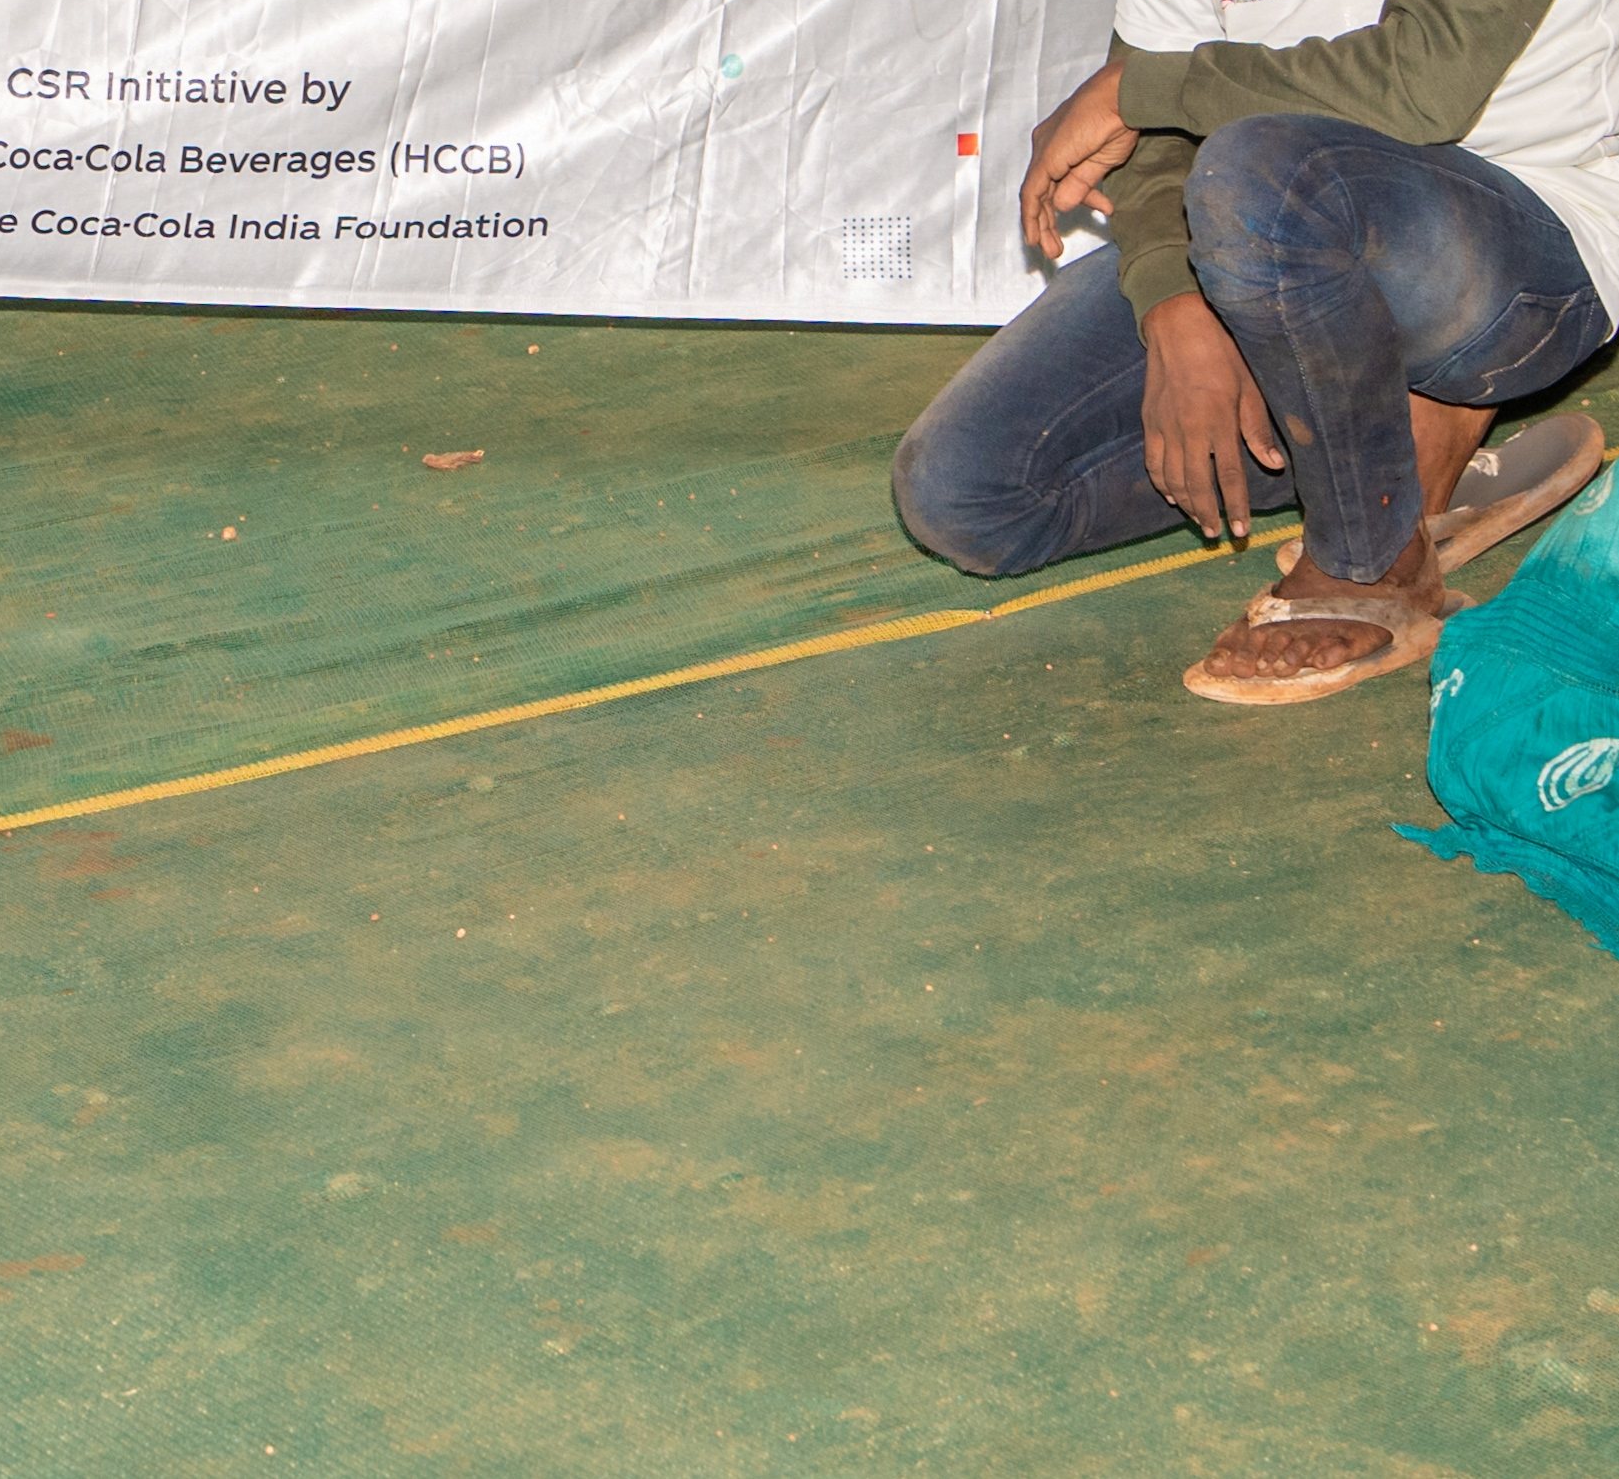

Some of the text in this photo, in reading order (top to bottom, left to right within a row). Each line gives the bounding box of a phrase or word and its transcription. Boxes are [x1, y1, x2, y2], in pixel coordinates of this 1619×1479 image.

[7, 67, 91, 101] CSR
[107, 70, 288, 106] Initiative
[300, 72, 353, 112] by
[179, 144, 376, 181] Beverages
[389, 141, 526, 180] (HCCB)
[31, 209, 216, 241] Coca-Cola
[230, 214, 322, 242] India
[334, 211, 550, 243] Foundation
